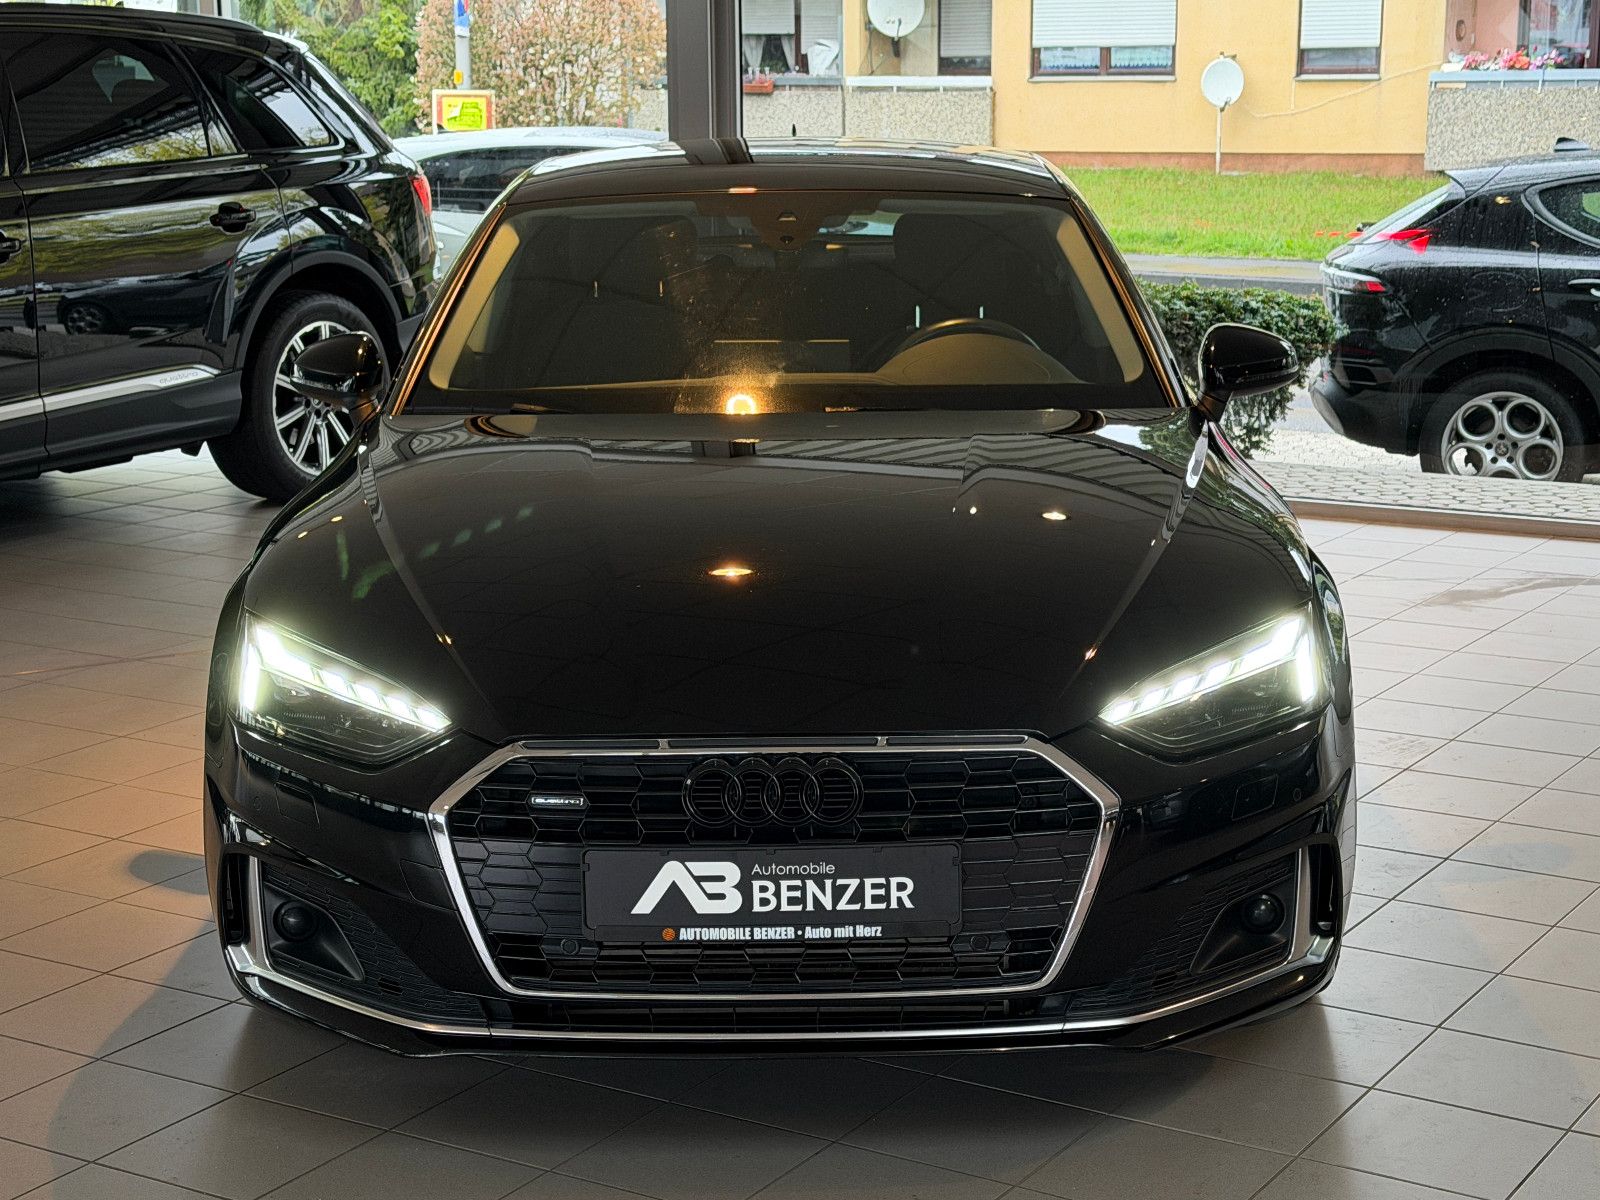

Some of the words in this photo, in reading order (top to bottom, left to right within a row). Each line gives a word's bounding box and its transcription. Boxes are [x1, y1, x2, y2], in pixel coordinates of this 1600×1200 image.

[751, 862, 836, 876] Automobile
[751, 877, 915, 912] BENZER
[679, 927, 752, 941] AUTOMOBILE
[753, 927, 796, 940] BENZER
[804, 926, 832, 939] Auto
[833, 925, 854, 938] mit
[855, 924, 882, 938] Herz
